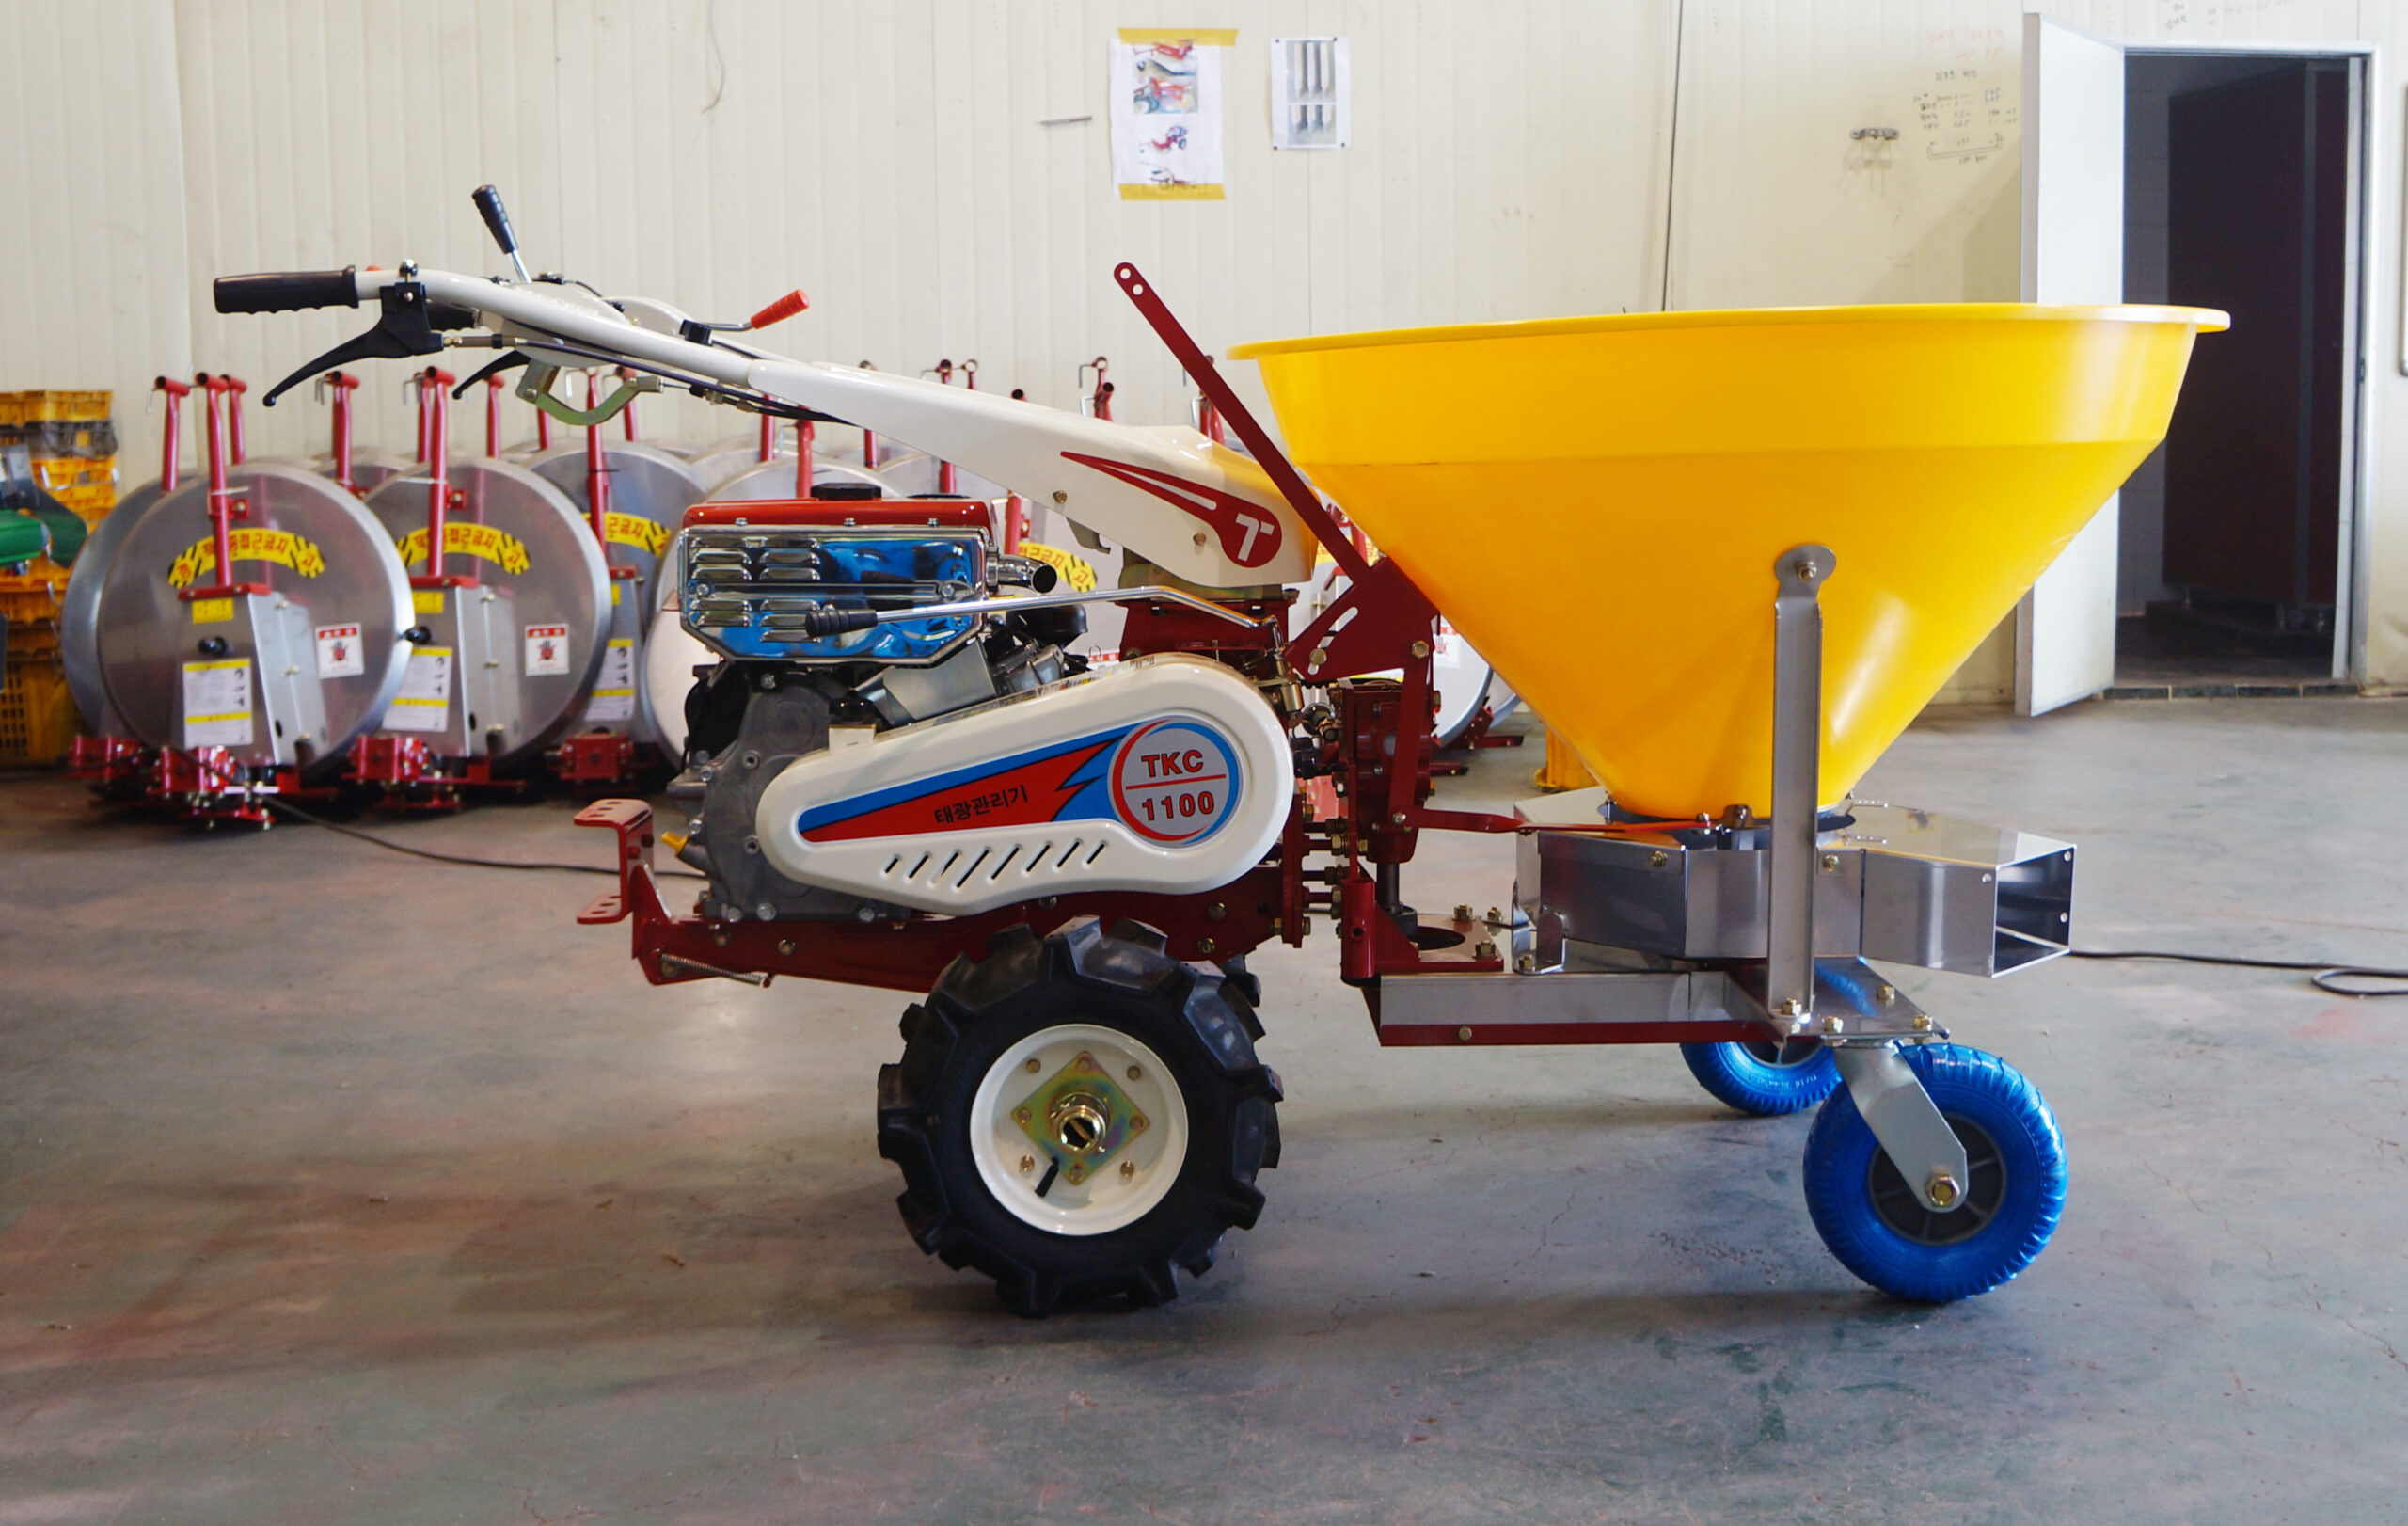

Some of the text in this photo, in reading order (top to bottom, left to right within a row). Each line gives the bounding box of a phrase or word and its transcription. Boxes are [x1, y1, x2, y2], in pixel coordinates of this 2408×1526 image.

[1141, 749, 1204, 778] TKC
[933, 784, 1029, 824] 태광관리기
[1141, 790, 1215, 821] 1100
